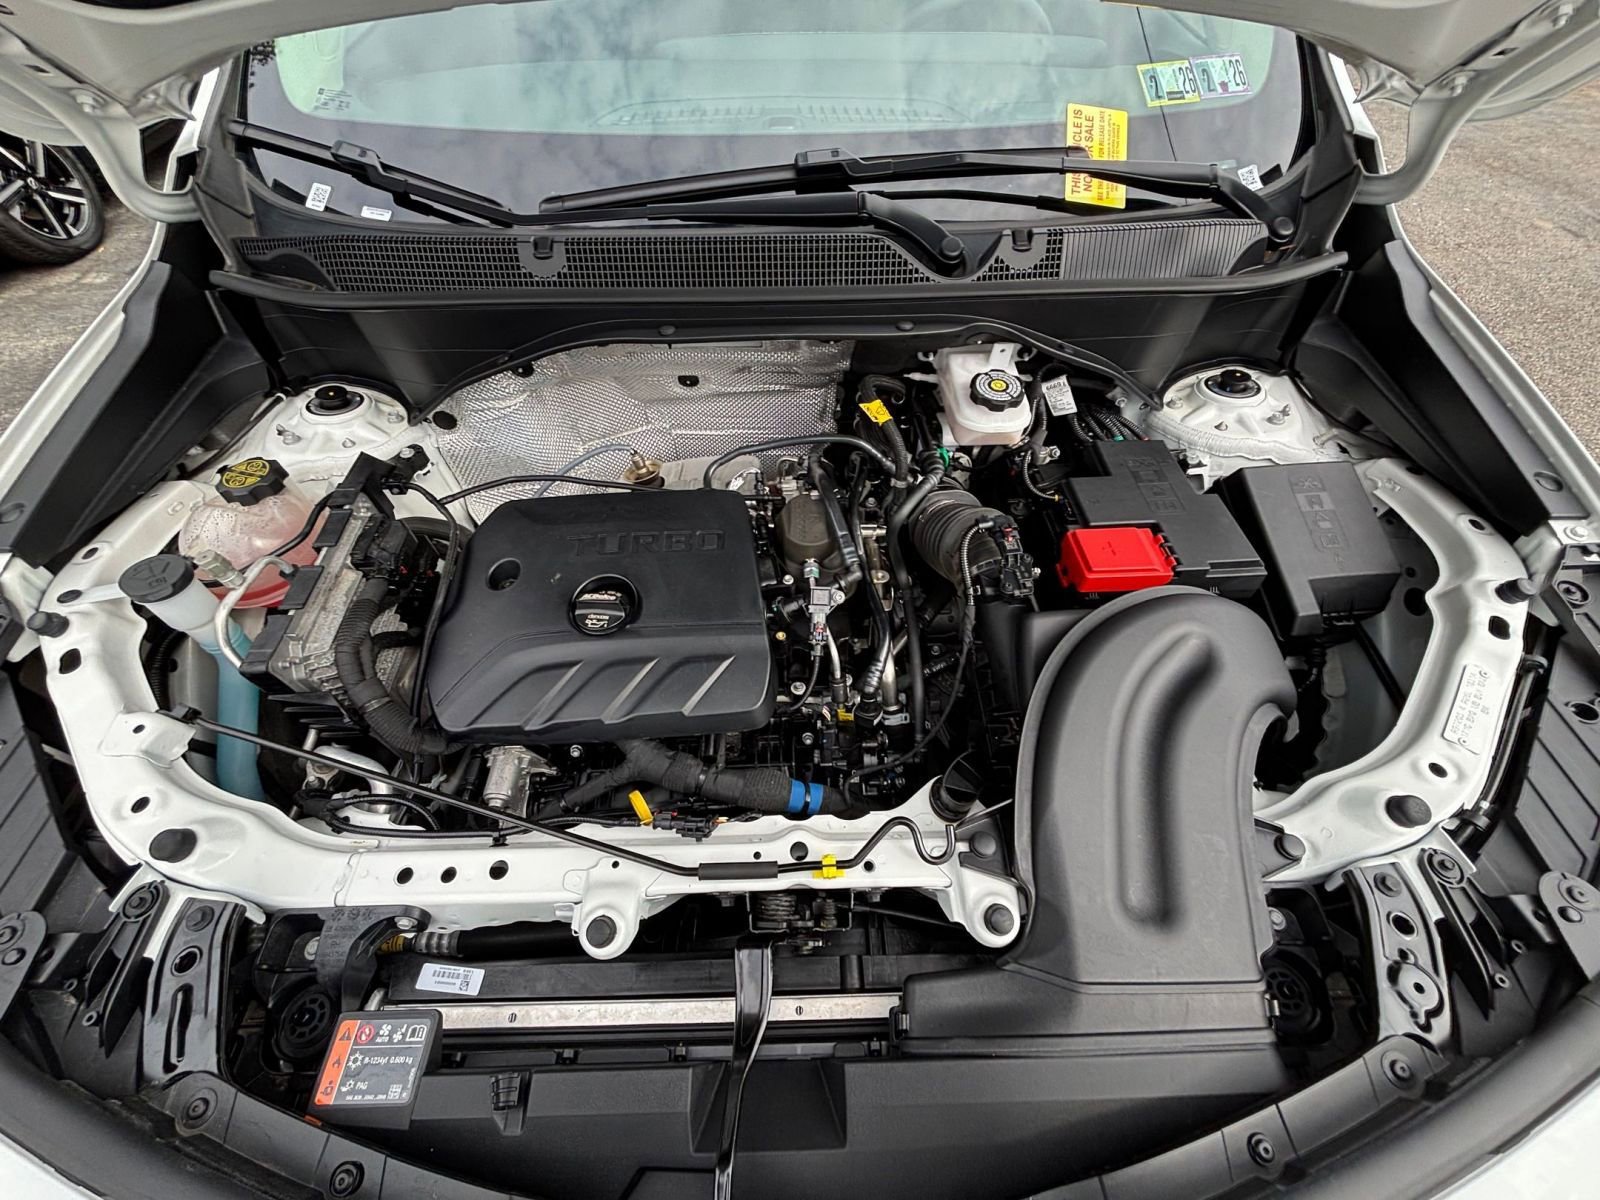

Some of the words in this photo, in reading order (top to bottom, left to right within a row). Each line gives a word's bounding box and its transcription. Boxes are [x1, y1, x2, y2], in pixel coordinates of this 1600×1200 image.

[1149, 75, 1163, 98] 2
[1179, 67, 1196, 94] 26
[1201, 68, 1217, 92] 2
[1229, 59, 1246, 86] 26
[1073, 109, 1083, 119] IS
[1084, 115, 1094, 143] SALE
[1083, 175, 1093, 192] NO
[567, 530, 725, 556] TURBO
